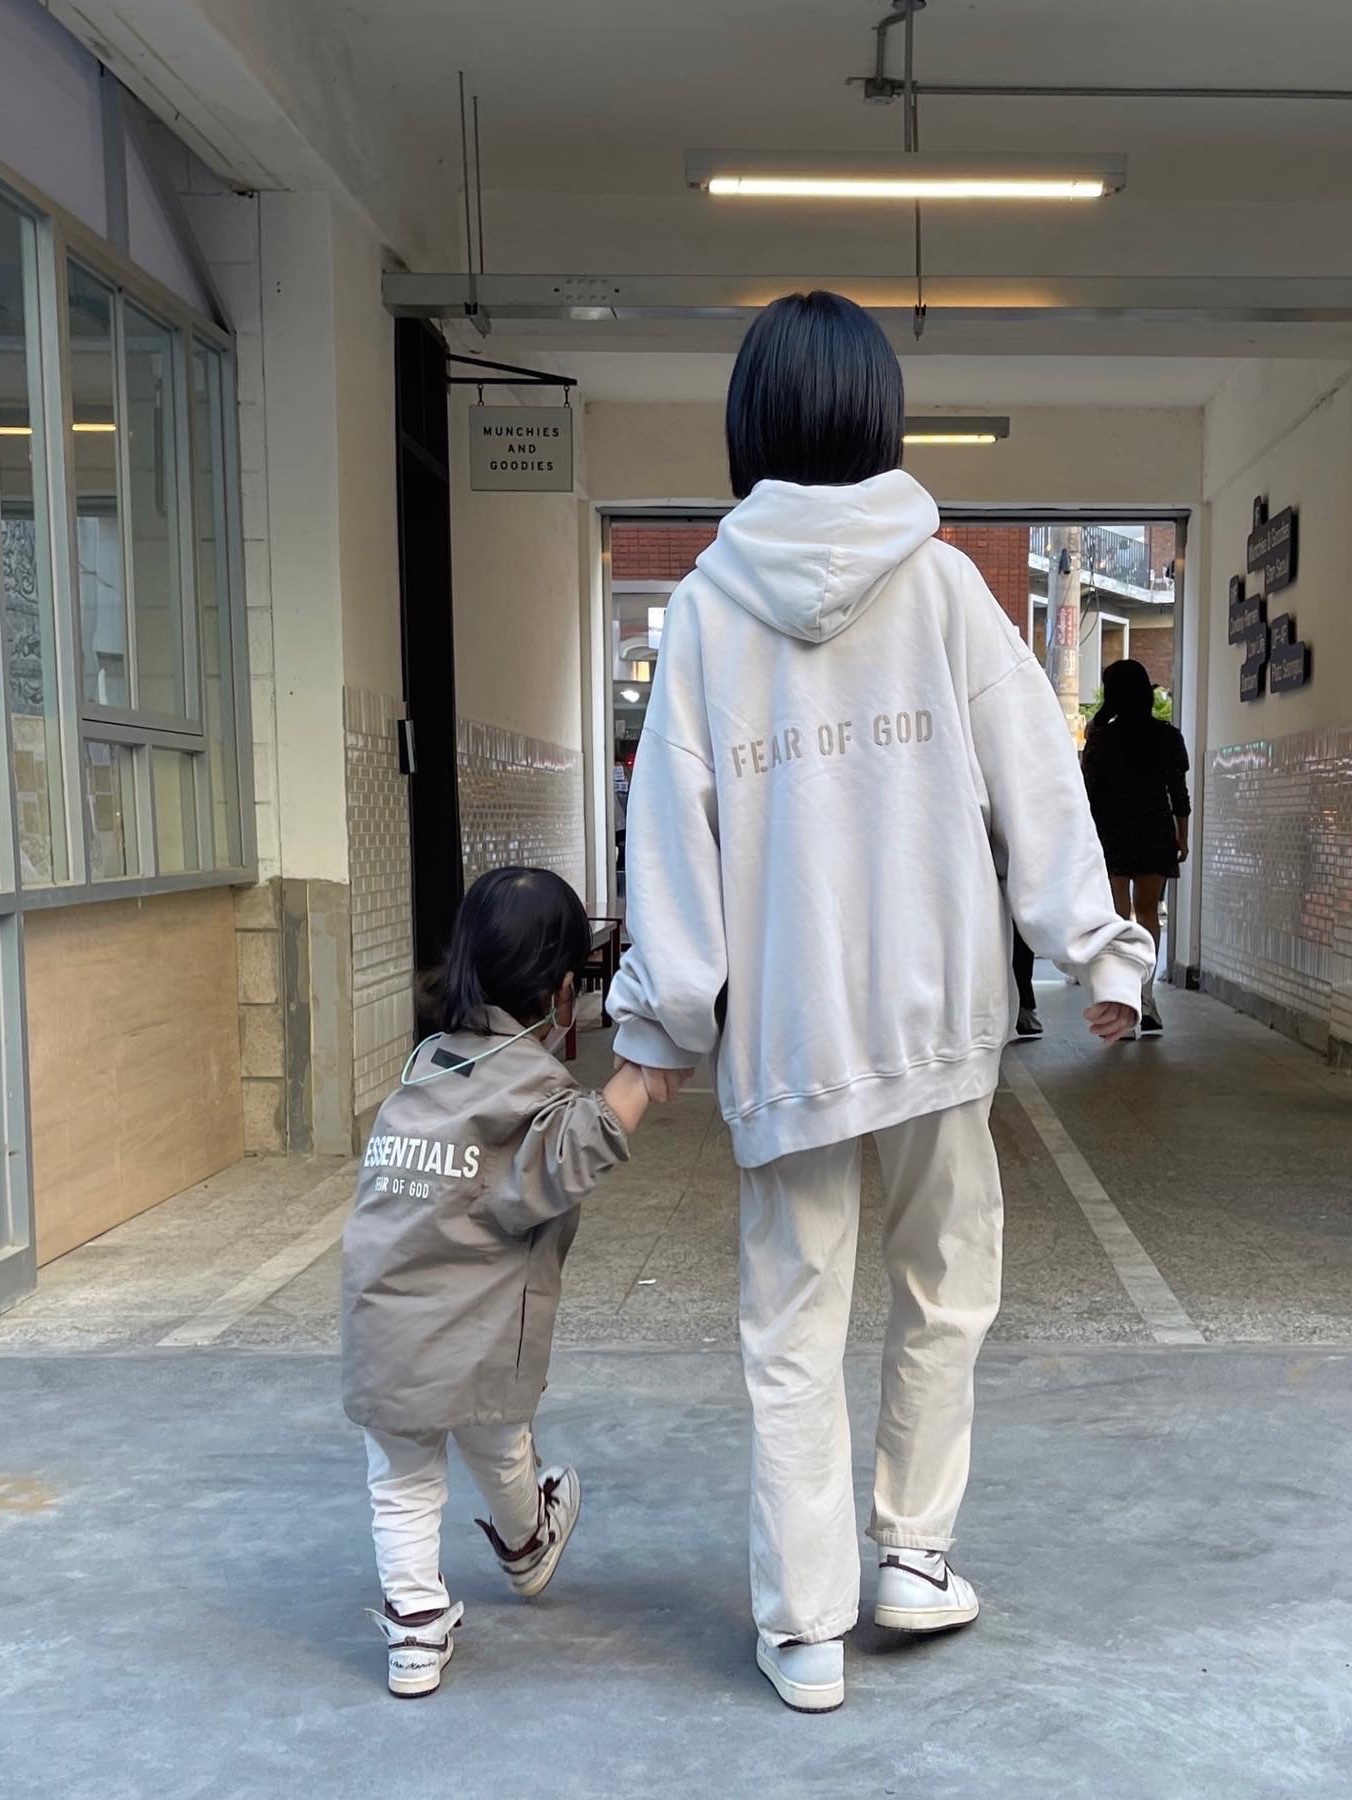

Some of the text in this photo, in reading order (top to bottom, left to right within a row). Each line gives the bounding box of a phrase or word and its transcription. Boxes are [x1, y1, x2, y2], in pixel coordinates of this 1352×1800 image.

[483, 426, 559, 437] MUNCHIES
[507, 444, 537, 454] AND
[490, 461, 554, 471] GOODIES
[731, 709, 933, 778] FEAR OF GOD
[363, 1135, 480, 1178] ESSENTIALS
[392, 1178, 405, 1195] OF
[409, 1181, 429, 1199] GOD
